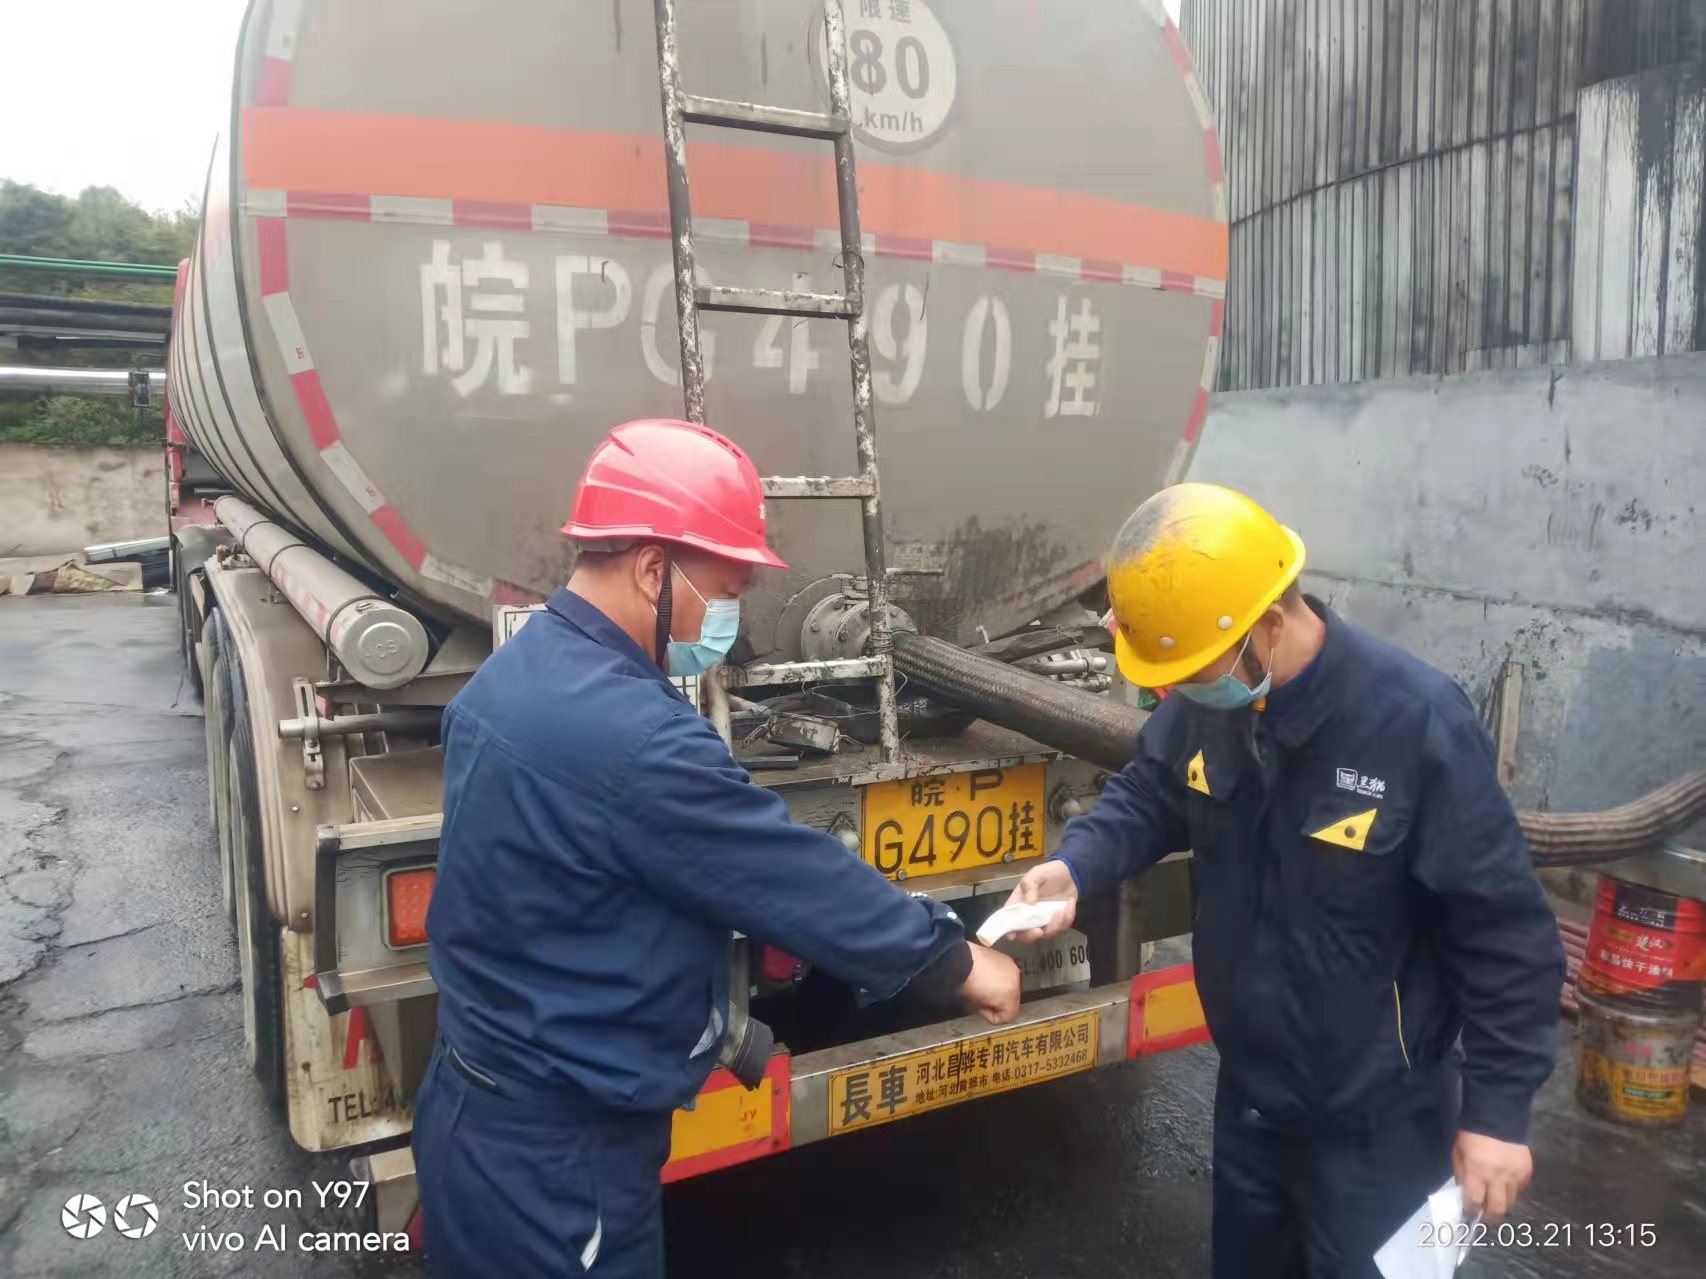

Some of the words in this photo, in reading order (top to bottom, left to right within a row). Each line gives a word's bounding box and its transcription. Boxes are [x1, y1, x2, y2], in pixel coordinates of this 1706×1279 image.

[850, 29, 930, 99] 80
[864, 106, 924, 133] km/h
[874, 800, 1037, 875] G490挂
